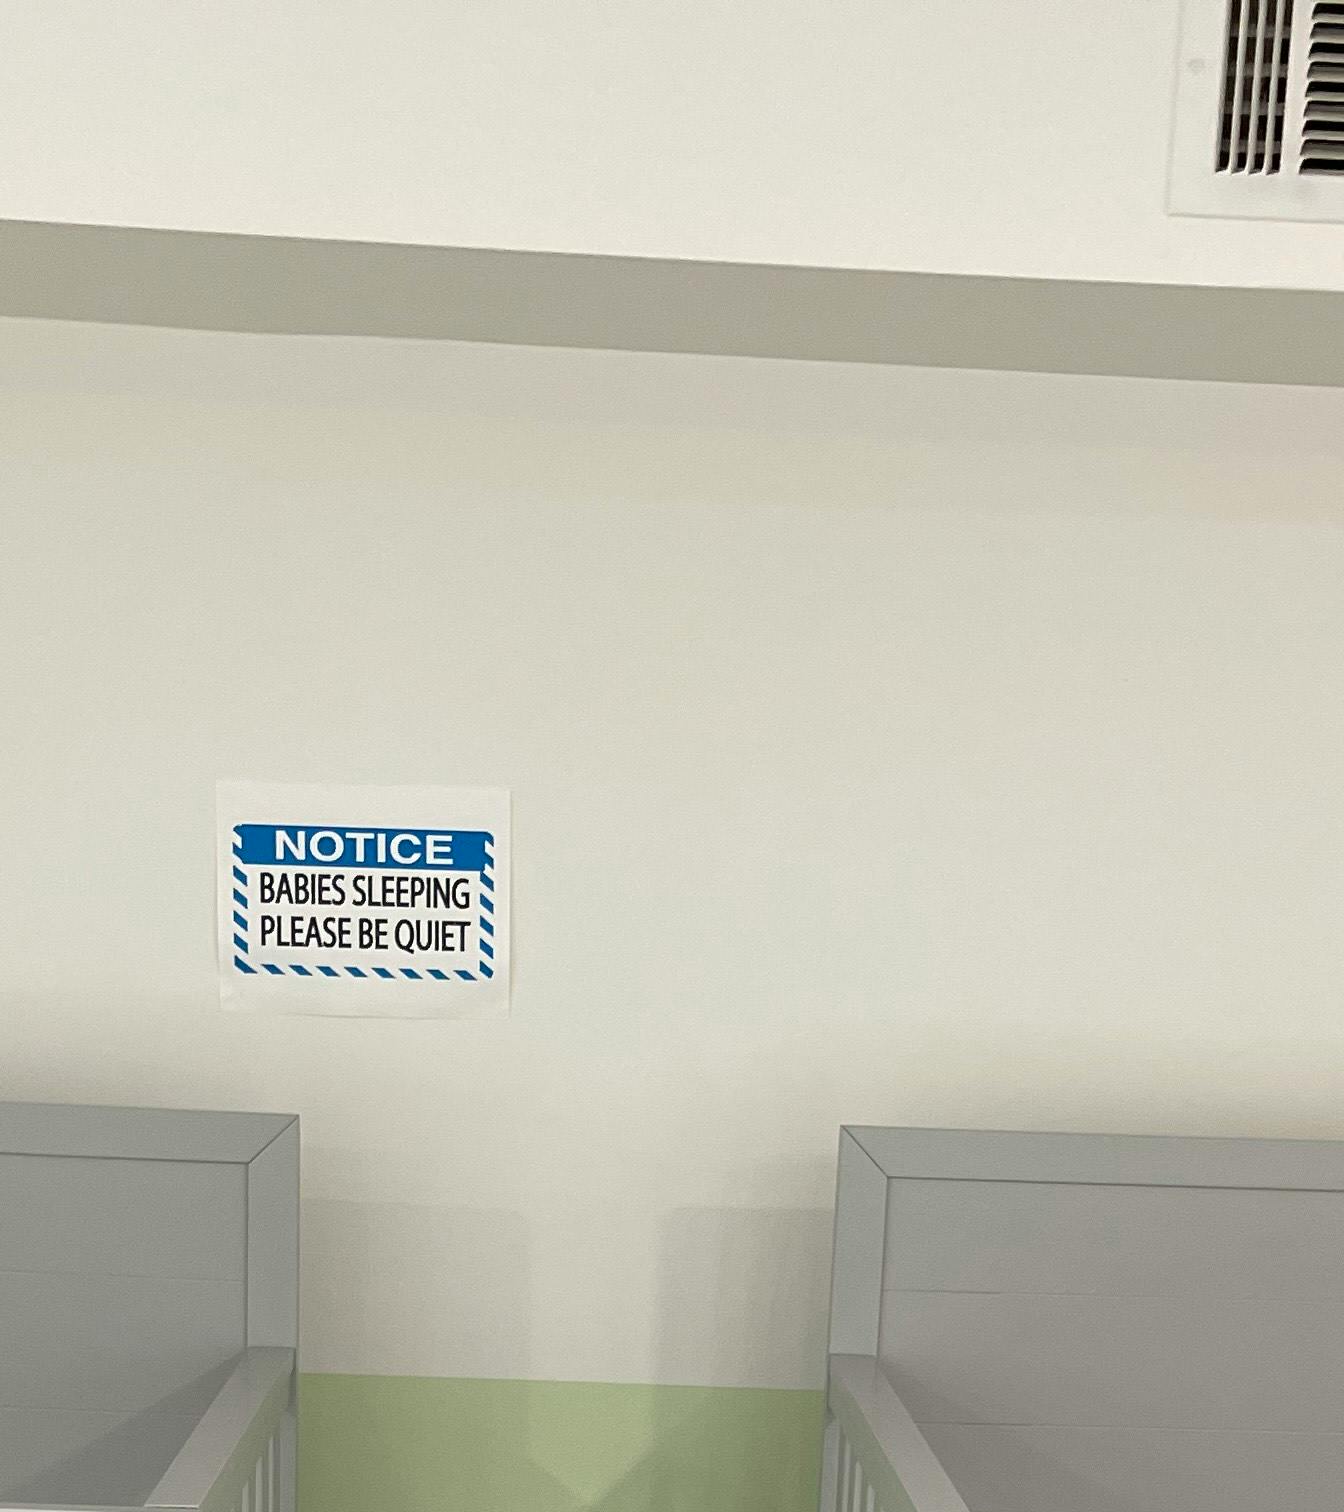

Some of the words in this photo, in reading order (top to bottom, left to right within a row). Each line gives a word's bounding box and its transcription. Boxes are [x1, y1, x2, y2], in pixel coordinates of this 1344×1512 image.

[274, 829, 454, 865] NOTICE
[259, 871, 346, 906] BABIES
[351, 874, 470, 910] SLEEPING
[260, 914, 352, 949] PLEASE
[358, 917, 389, 950] BE
[394, 918, 471, 954] QUIET
